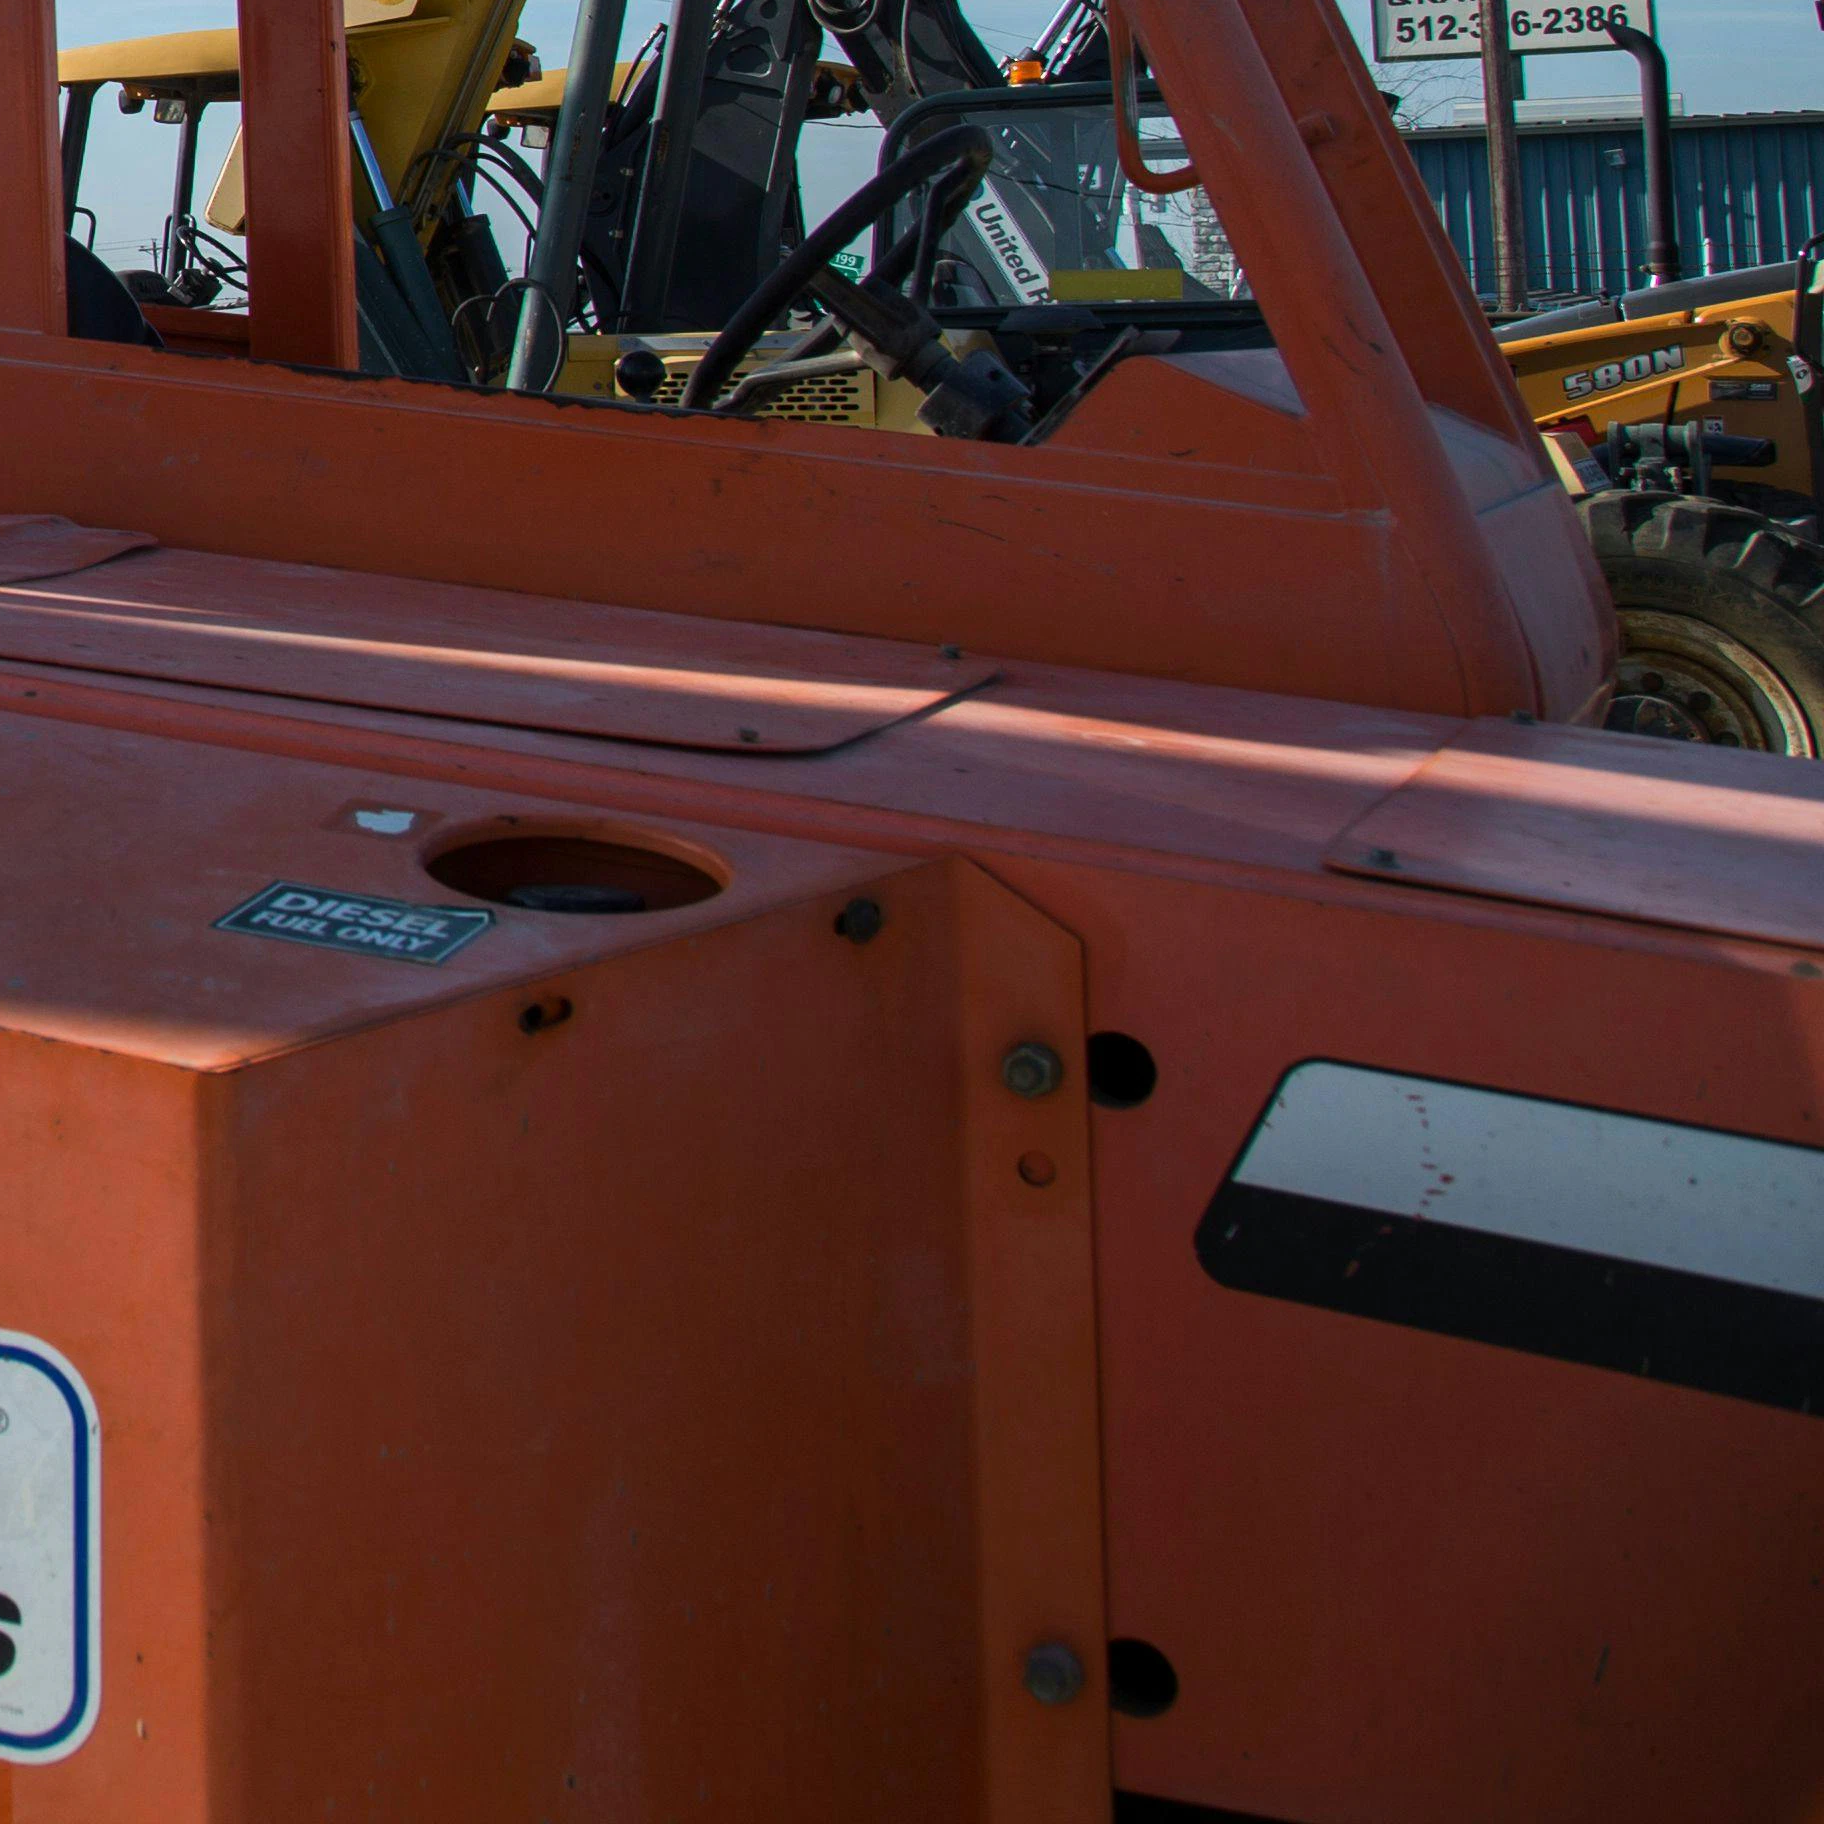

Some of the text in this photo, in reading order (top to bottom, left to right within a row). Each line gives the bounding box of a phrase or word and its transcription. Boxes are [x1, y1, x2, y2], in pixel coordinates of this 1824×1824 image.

[1396, 4, 1628, 43] 512-36-2386
[835, 252, 857, 267] 199
[975, 201, 1040, 286] United
[1562, 342, 1685, 401] 580N
[251, 909, 435, 952] FUEL ONLY
[268, 891, 451, 939] DIESEL
